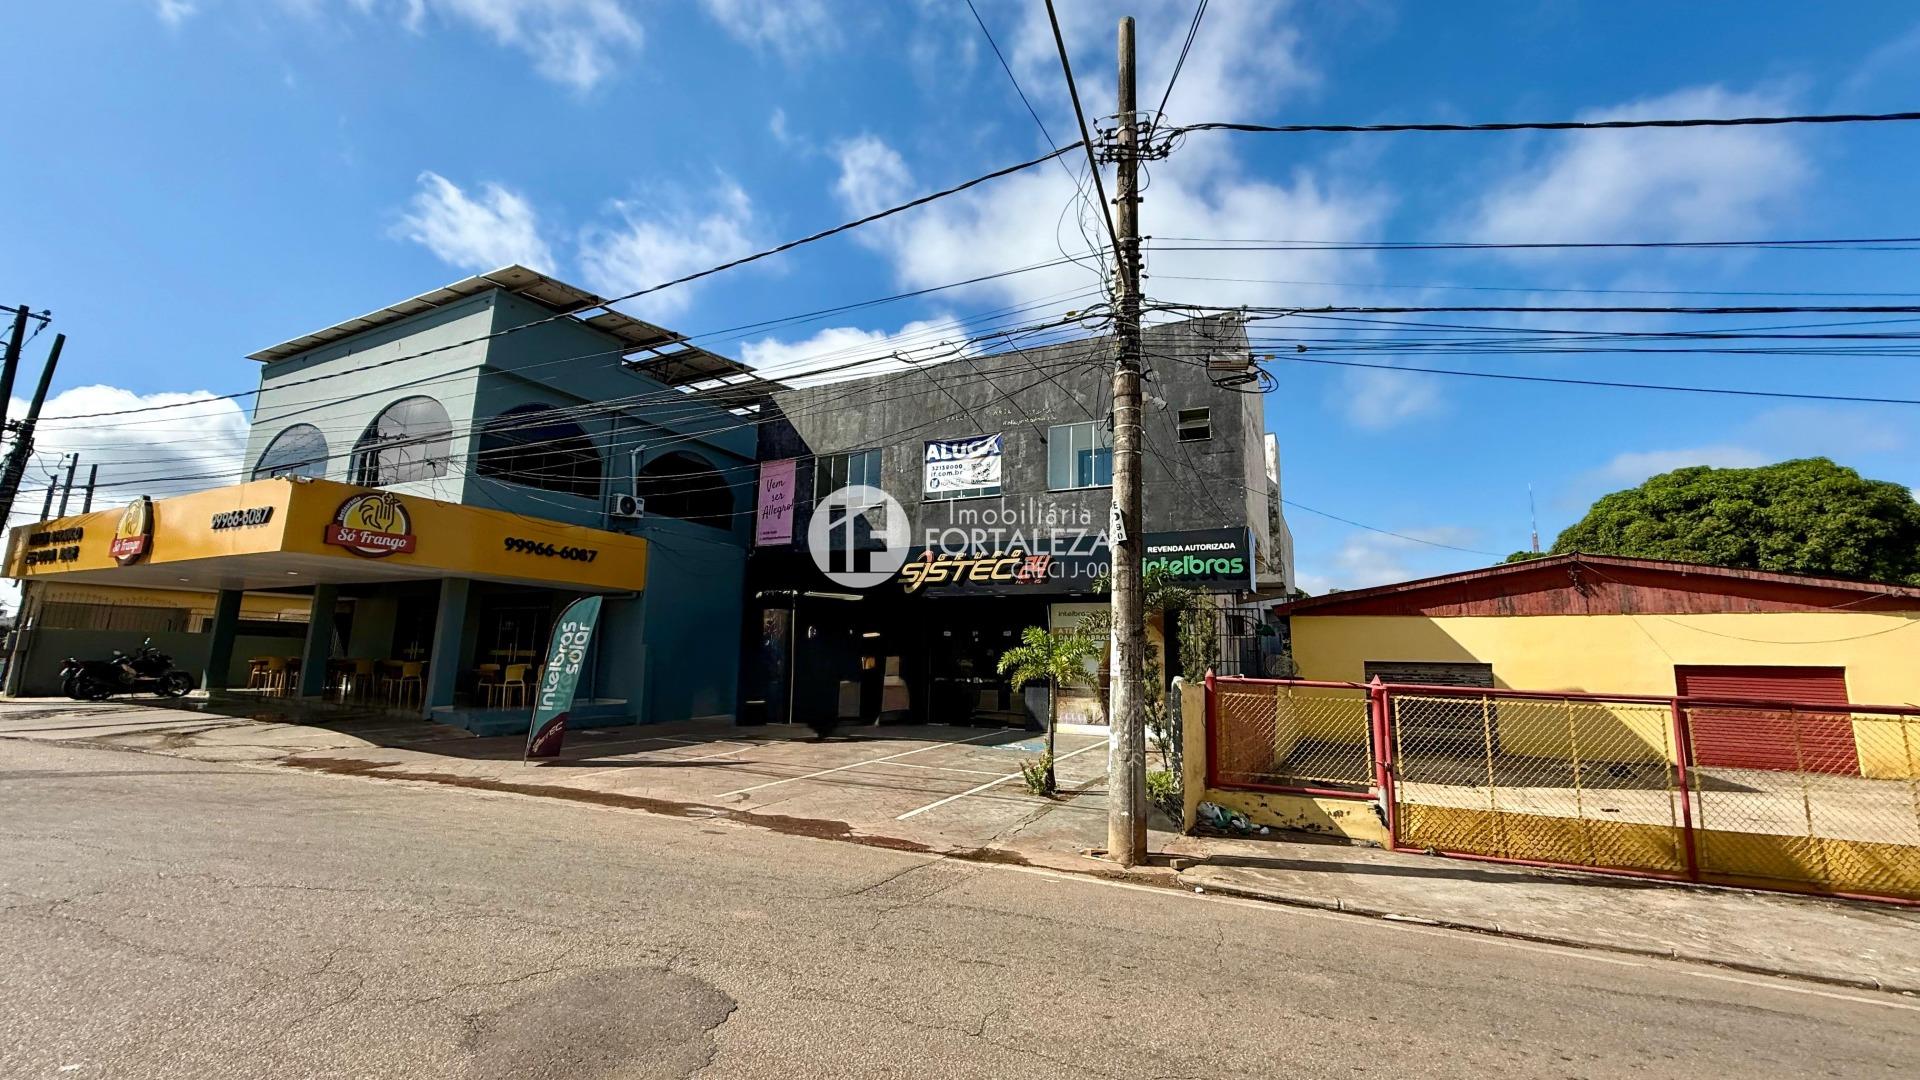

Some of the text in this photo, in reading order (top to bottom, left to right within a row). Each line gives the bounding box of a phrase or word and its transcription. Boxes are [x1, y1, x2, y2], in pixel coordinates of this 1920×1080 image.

[766, 479, 785, 492] Vem
[772, 493, 785, 502] ser
[211, 506, 273, 529] 99966-6087
[337, 528, 406, 549] Só Frango
[504, 537, 598, 562] 99966-6087
[1147, 542, 1236, 553] REVENDA AUTORIZADA
[1142, 555, 1244, 577] intelbras
[566, 622, 591, 675] solar
[539, 621, 577, 711] intelbras
